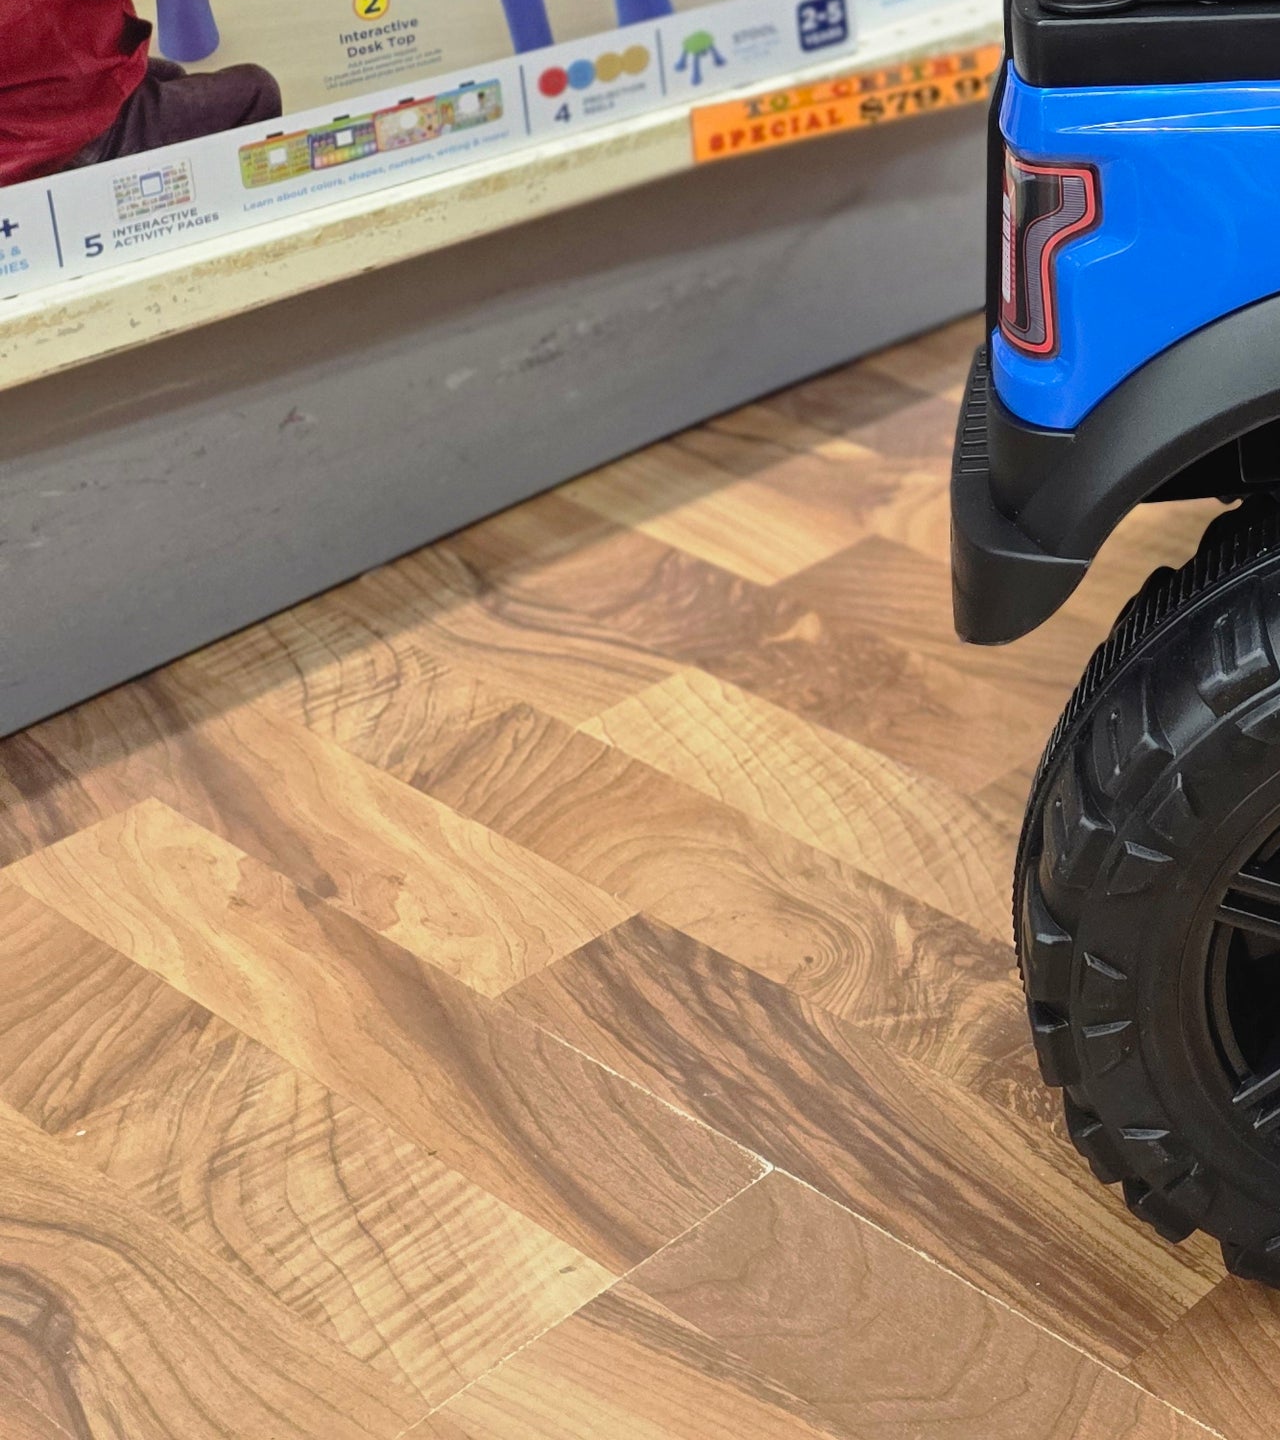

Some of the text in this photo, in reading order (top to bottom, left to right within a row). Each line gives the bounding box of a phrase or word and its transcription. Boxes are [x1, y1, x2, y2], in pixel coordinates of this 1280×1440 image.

[802, 1, 841, 30] 2-5
[340, 17, 418, 44] Interactive
[347, 41, 383, 58] Desk
[387, 34, 415, 47] Top
[554, 102, 571, 122] 4
[709, 108, 843, 152] SPECIAL
[243, 197, 274, 212] Learn
[276, 187, 308, 202] about
[84, 207, 198, 257] 5 INTERACTIVE
[114, 212, 219, 248] ACTIVITY PAGES
